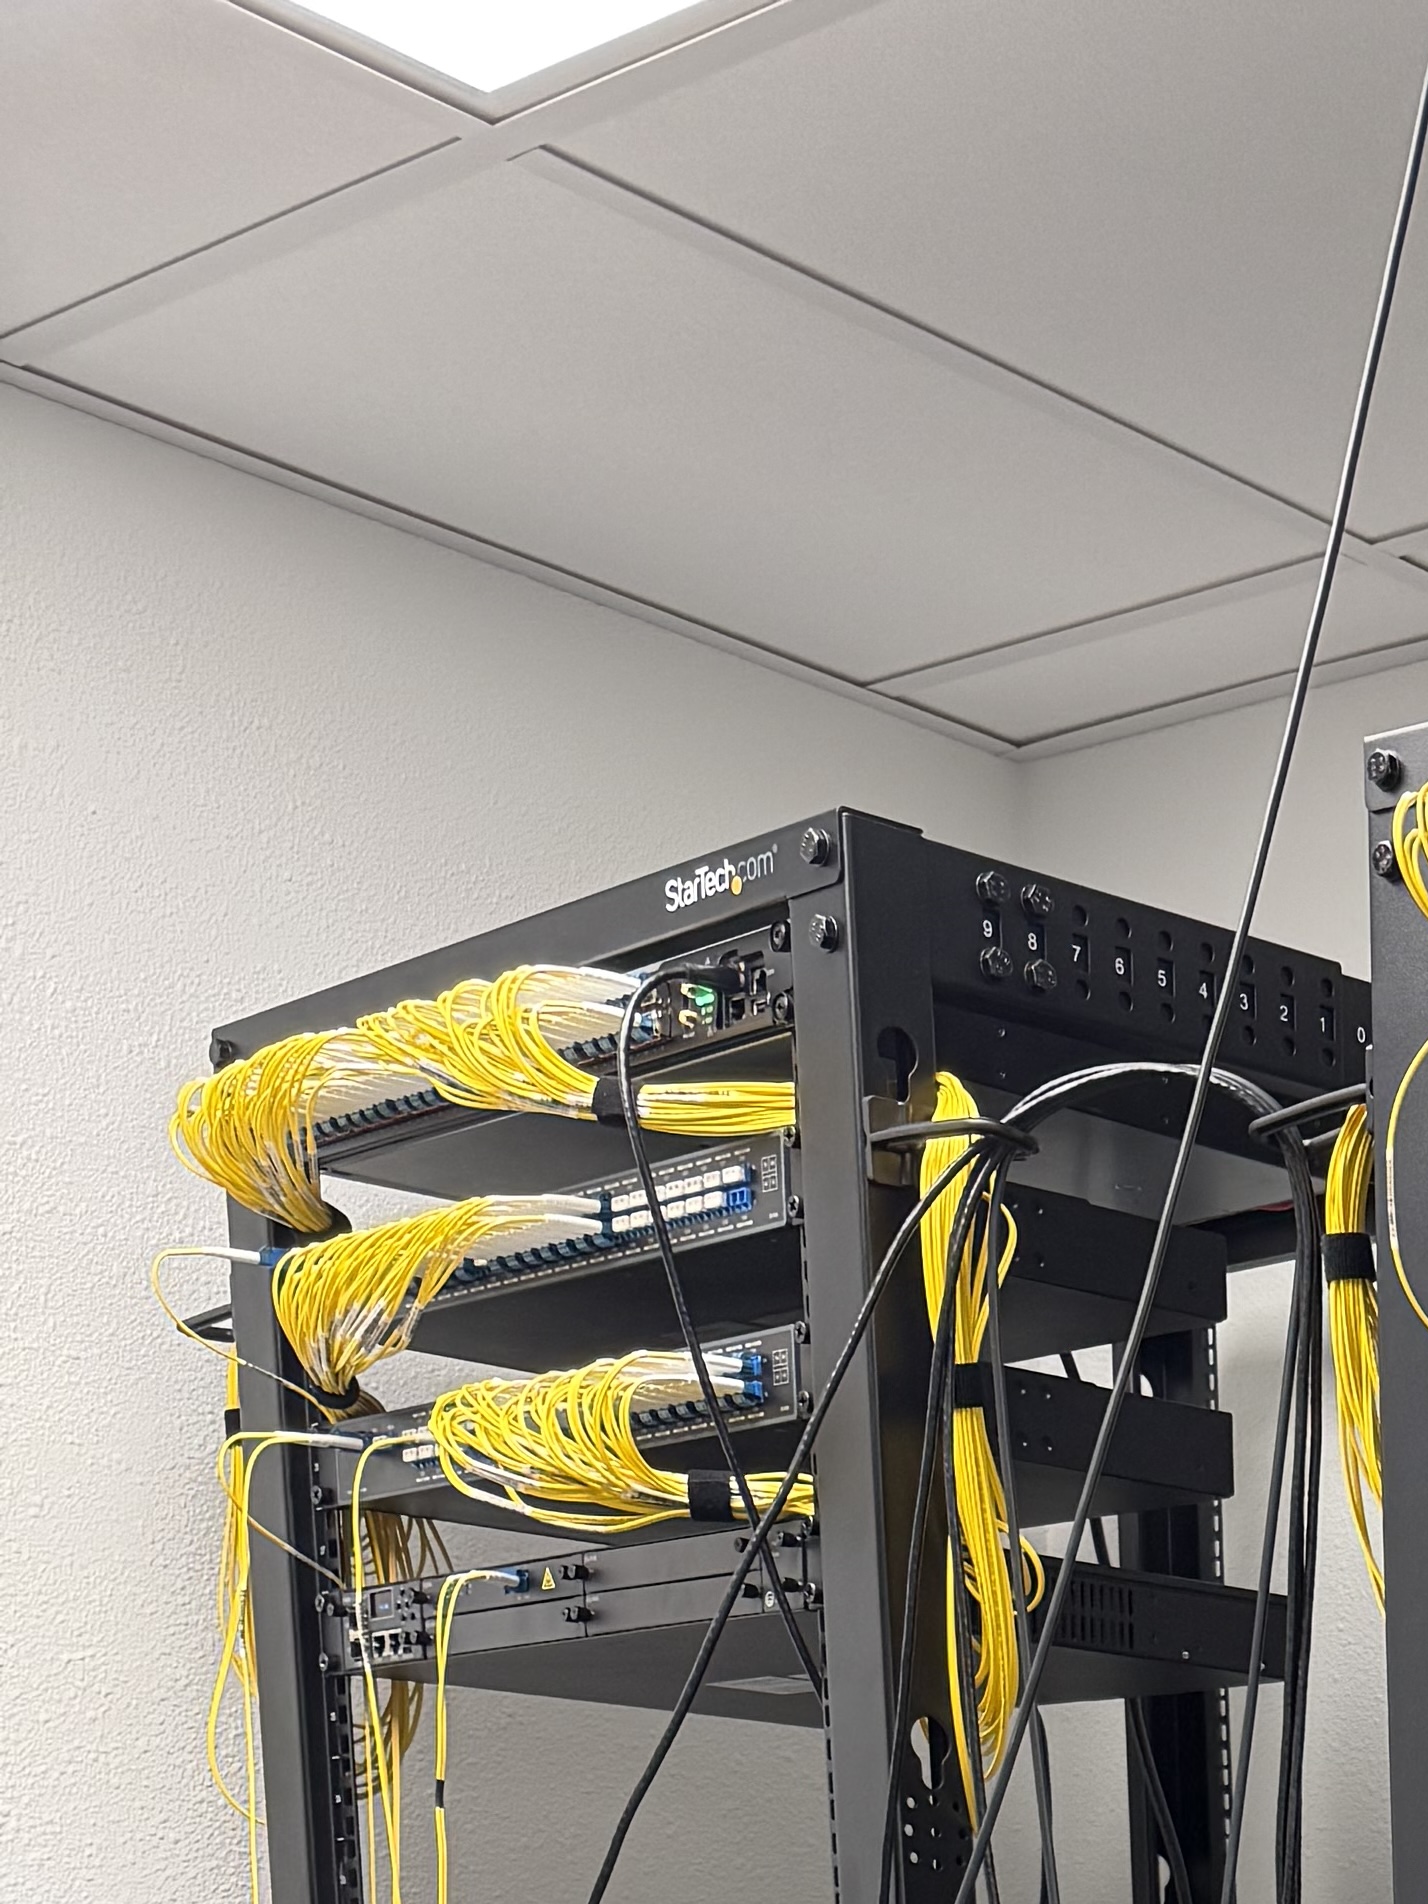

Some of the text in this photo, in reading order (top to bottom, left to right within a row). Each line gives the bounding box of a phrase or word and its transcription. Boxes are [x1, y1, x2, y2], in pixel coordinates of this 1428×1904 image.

[983, 920, 992, 937] 9
[1028, 933, 1037, 950] 8
[1073, 945, 1080, 961] 7
[1116, 958, 1124, 974] 6
[1158, 970, 1166, 986] 5
[1240, 994, 1248, 1010] 3
[1280, 1006, 1287, 1021] 2
[1321, 1018, 1324, 1032] 1
